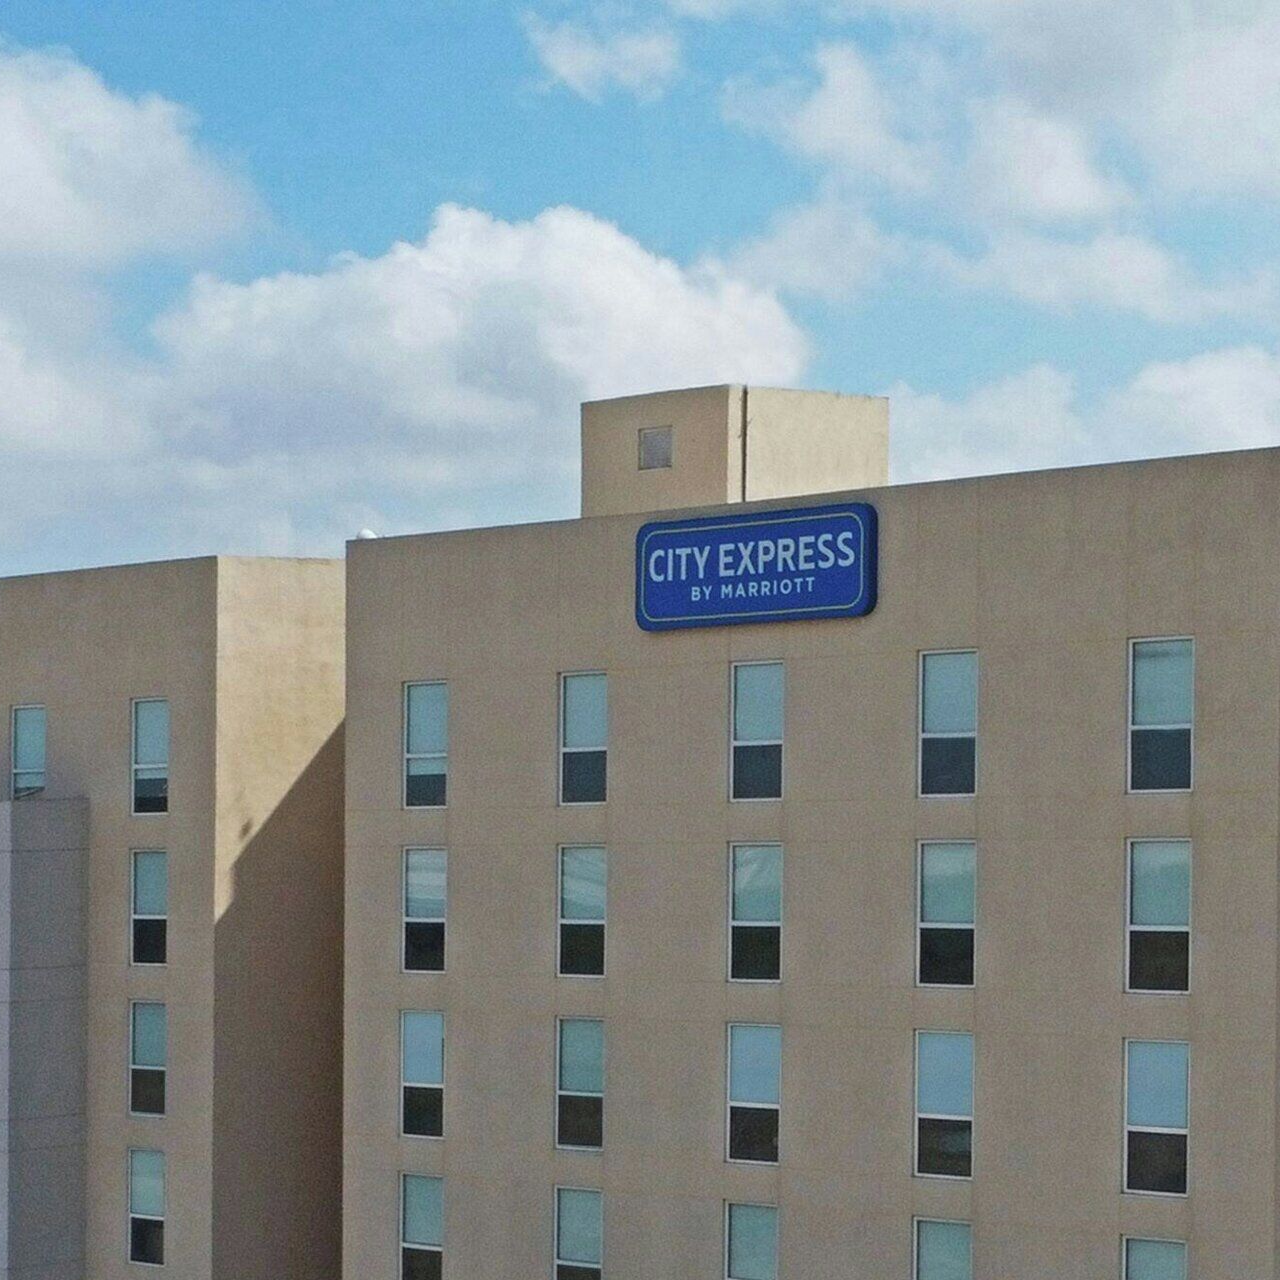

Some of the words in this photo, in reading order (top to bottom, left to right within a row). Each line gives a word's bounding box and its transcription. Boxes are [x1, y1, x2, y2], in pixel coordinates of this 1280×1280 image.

[649, 545, 711, 582] CITY
[719, 531, 856, 577] EXPRESS
[691, 586, 713, 601] BY
[721, 576, 816, 599] MARRIOTT
